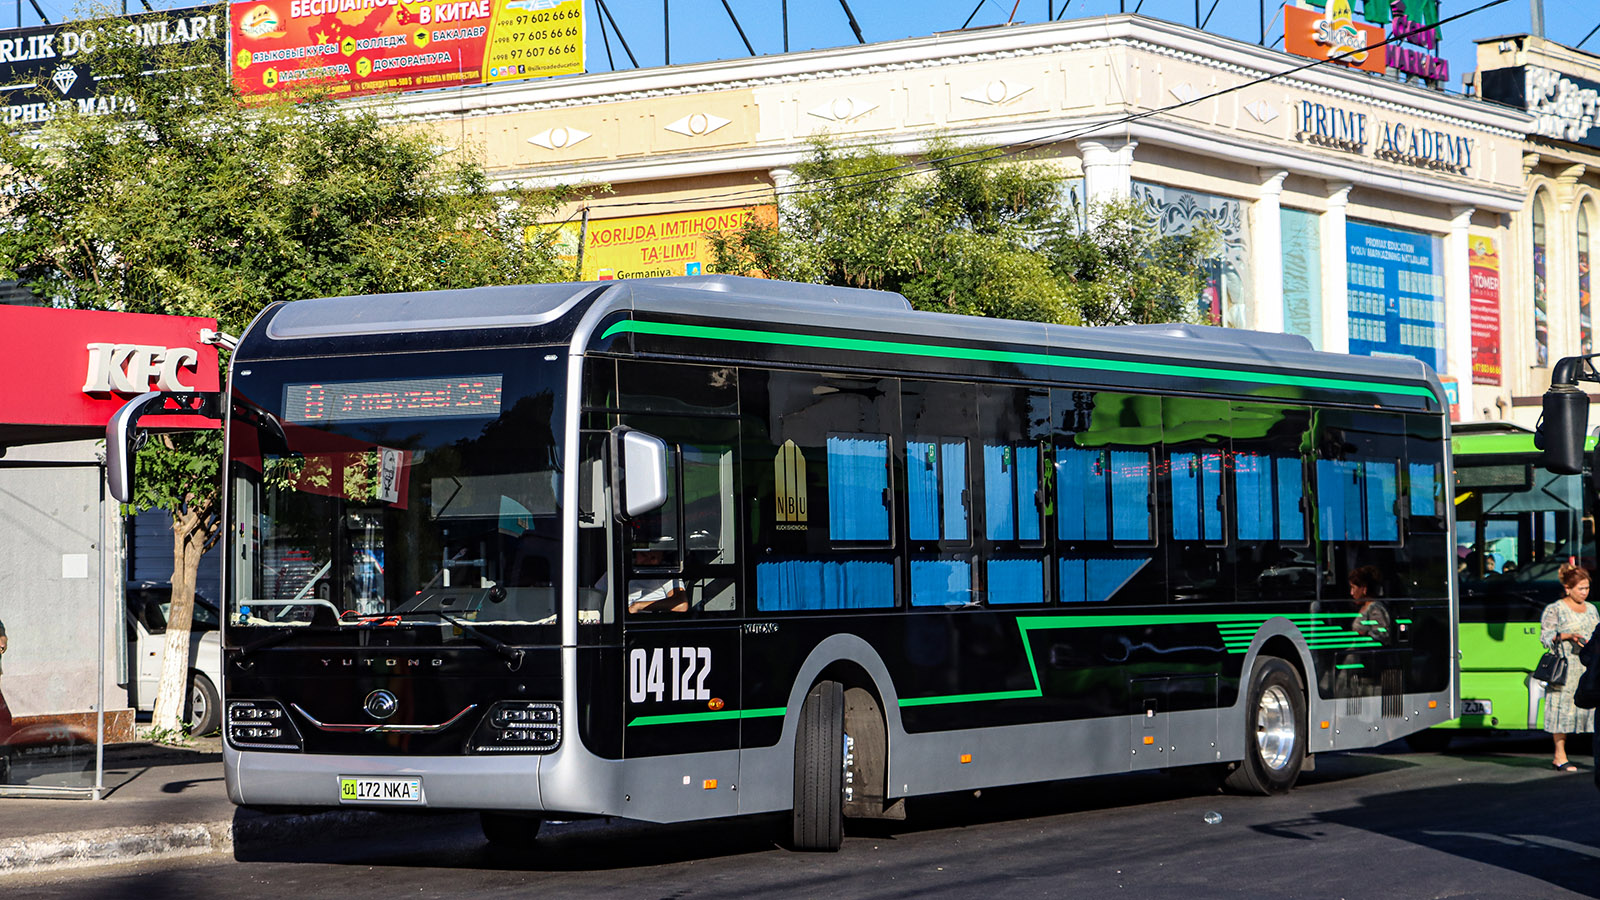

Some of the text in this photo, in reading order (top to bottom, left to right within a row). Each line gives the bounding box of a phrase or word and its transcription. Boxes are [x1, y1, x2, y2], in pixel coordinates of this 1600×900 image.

[420, 1, 490, 24] В КИТАЕ
[516, 15, 528, 25] 97
[531, 12, 550, 23] 602
[552, 10, 565, 21] 66
[567, 8, 580, 19] 66
[356, 35, 407, 50] КОЛЛЕДЖ
[432, 27, 486, 41] БАКАЛАВР
[494, 26, 578, 44] +998 97 605 66 66
[1319, 20, 1367, 49] SilkRoad
[252, 43, 339, 63] ЯЗЫКОВЫЕ КУРСЫ
[492, 43, 576, 61] +998 97 607 66 66
[373, 52, 451, 72] ДОКТОРАНТУРА
[1303, 100, 1474, 169] PRIME ACADEMY
[590, 223, 656, 248] XORIJDA
[641, 242, 696, 264] TA'LIM!
[617, 266, 671, 280] Germaniya
[82, 343, 198, 393] KFC
[777, 496, 806, 515] NBU
[1523, 627, 1536, 635] LE
[344, 783, 355, 796] 01
[358, 782, 380, 798] 172
[384, 783, 410, 798] NKA
